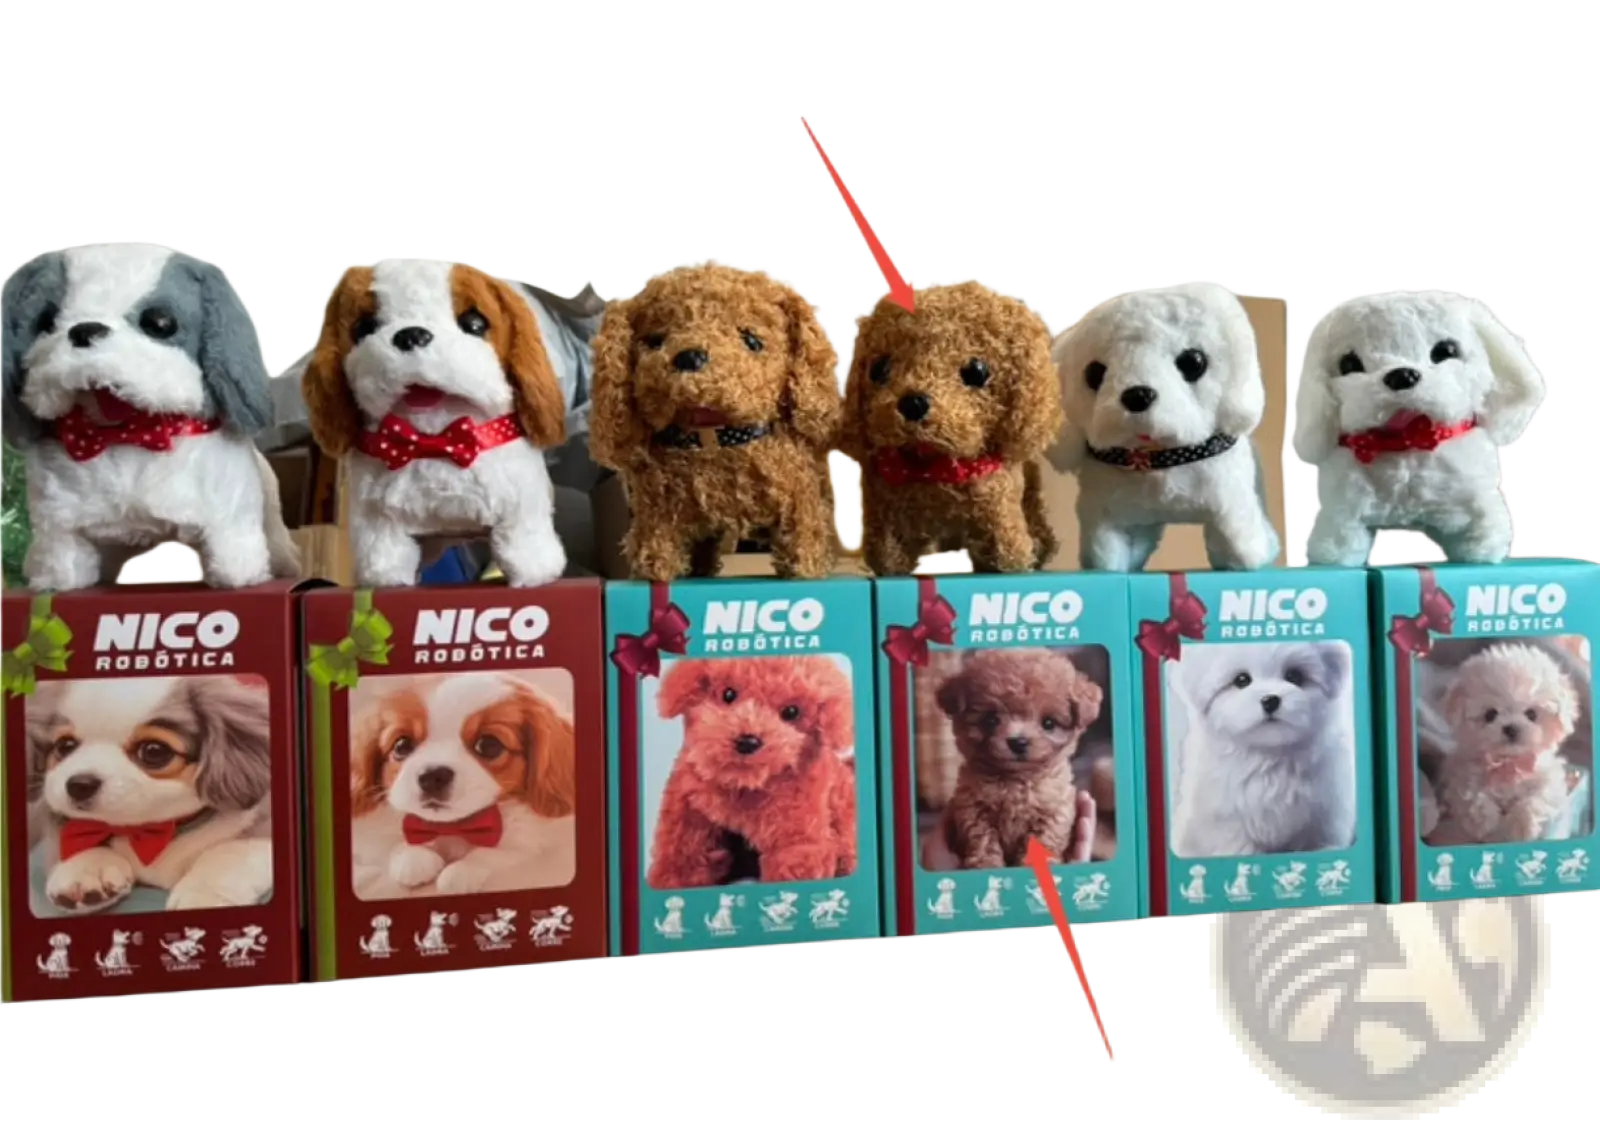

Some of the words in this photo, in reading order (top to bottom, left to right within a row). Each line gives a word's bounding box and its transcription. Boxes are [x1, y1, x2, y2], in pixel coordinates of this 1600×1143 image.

[703, 597, 824, 635] NICO
[969, 589, 1083, 626] NICO
[1218, 587, 1328, 622] NICO
[1465, 582, 1567, 616] NICO
[93, 610, 240, 651] NICO
[412, 605, 549, 646] NICO
[970, 625, 1079, 643] ROBÓTICA
[1221, 621, 1325, 638] ROBÓTICA
[414, 643, 545, 664] ROBÓTICA
[704, 634, 820, 652] ROBÓTICA
[95, 650, 234, 671] ROBÓTICA
